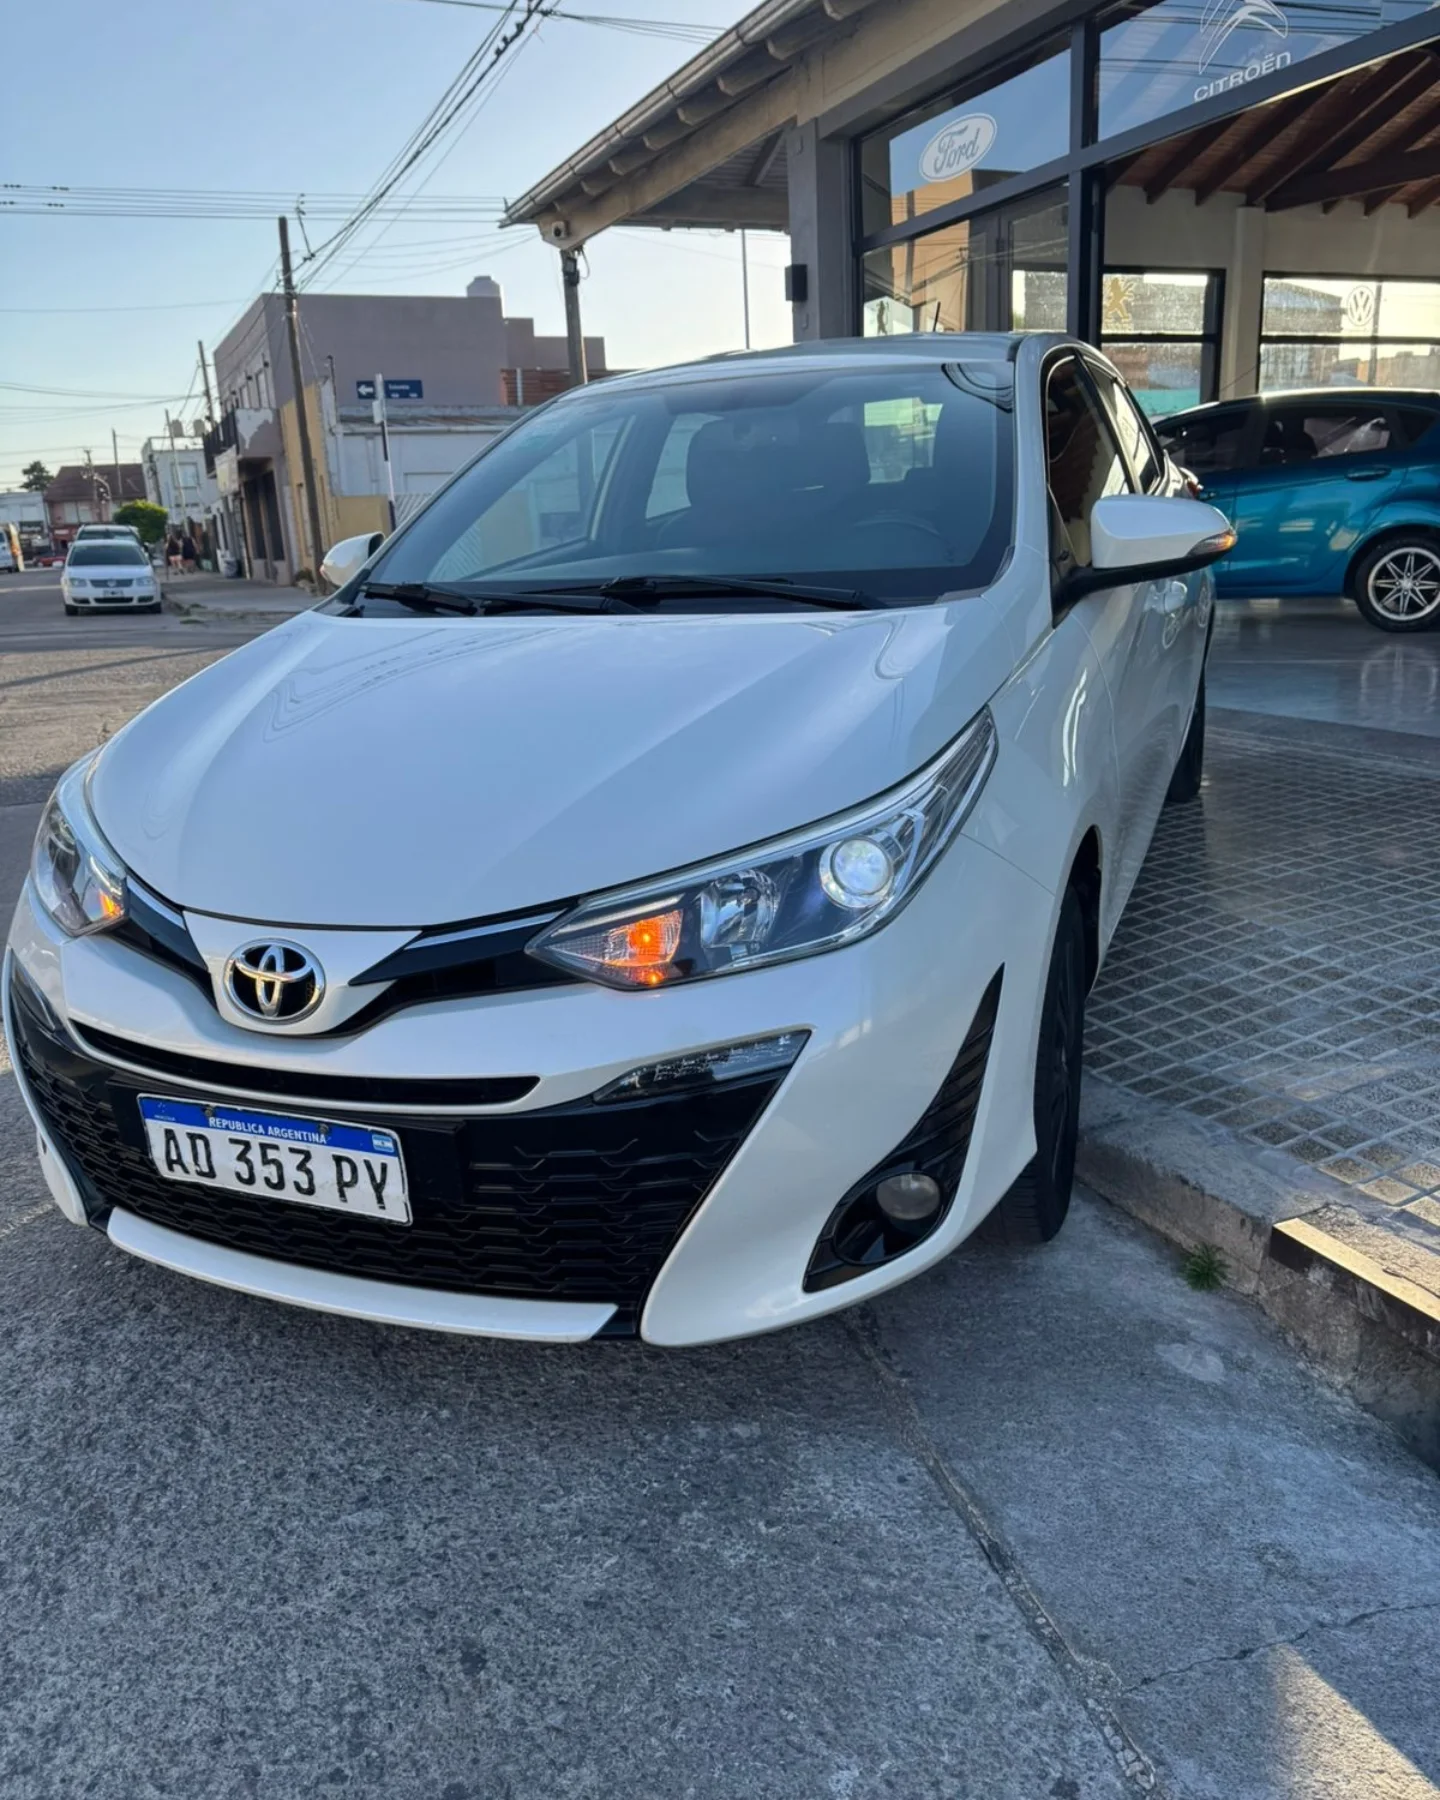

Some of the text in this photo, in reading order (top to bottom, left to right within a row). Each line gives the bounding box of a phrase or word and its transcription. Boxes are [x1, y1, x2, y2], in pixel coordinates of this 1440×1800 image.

[933, 124, 981, 174] Ford
[208, 1116, 327, 1144] REPUBLICA ARGENTINA
[163, 1128, 388, 1210] AD 353 PY
